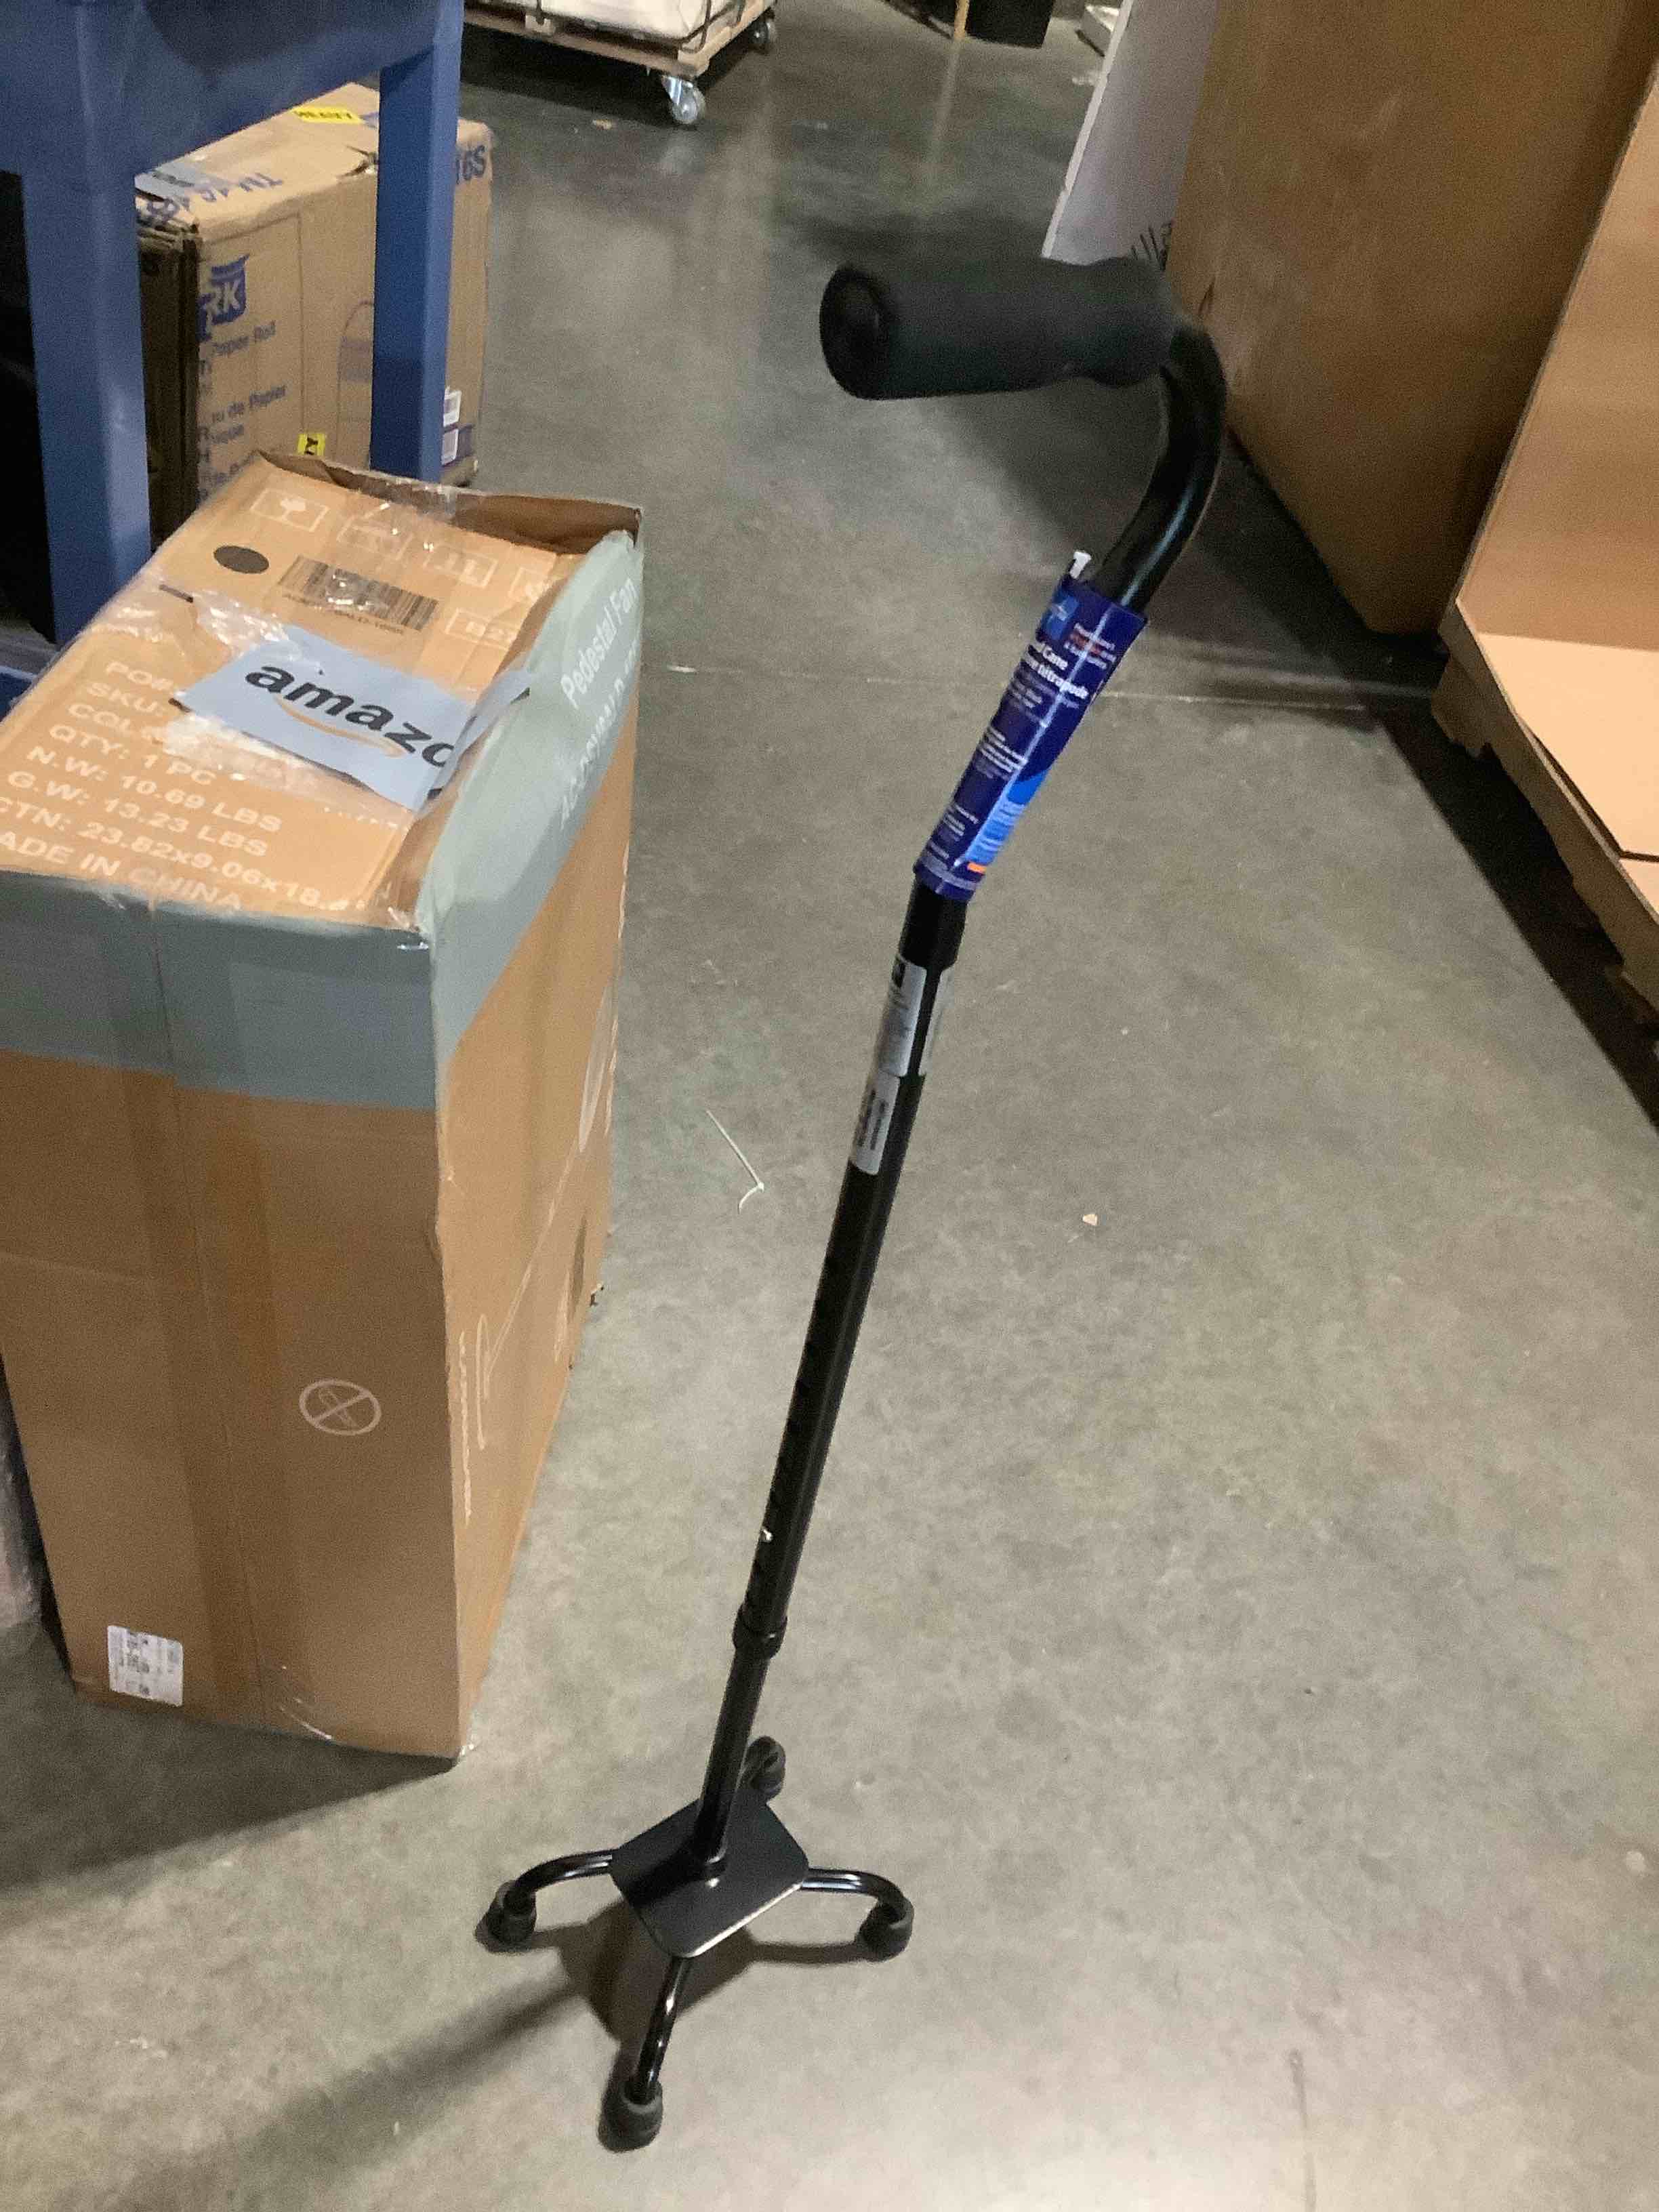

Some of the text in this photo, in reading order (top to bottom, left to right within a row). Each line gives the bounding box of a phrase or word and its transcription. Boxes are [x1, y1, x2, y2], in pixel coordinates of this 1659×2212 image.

[560, 606, 618, 710] Pedestal
[609, 578, 638, 625] Fan
[27, 745, 282, 832] N.W: 10.69 LBS
[49, 724, 216, 785] QTY: 1 PC
[8, 771, 268, 857] G.W: 13.23 LBS
[80, 853, 121, 877] IN
